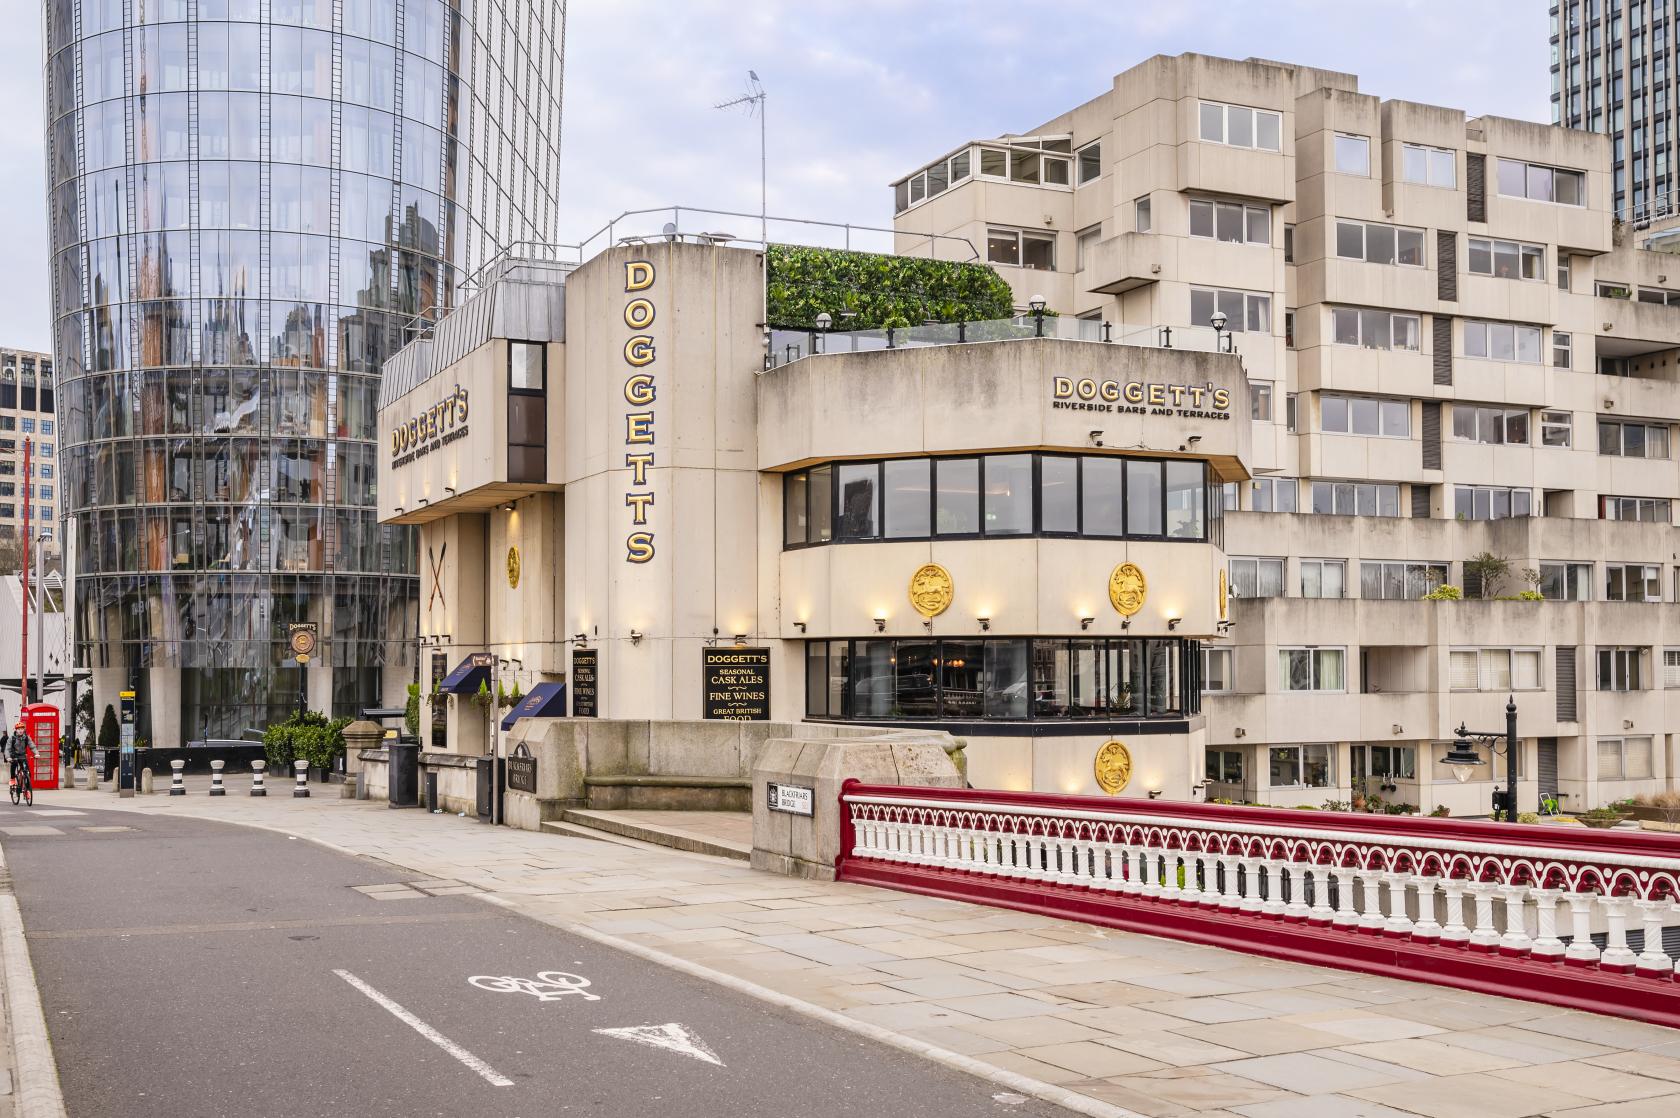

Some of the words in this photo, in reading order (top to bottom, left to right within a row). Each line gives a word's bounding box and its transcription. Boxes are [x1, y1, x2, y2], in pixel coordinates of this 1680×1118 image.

[1054, 376, 1230, 410] DOGGETT'S
[624, 260, 656, 564] DOGGETTS
[1053, 401, 1113, 413] RIVERSIDE
[1117, 405, 1147, 415] BARS
[1150, 407, 1173, 416] AND
[1176, 409, 1231, 421] TERRACES
[391, 383, 469, 457] DOGGETT'S
[707, 655, 768, 663] DOGGETT'S
[711, 676, 737, 685] CASK
[739, 675, 763, 684] ALES
[709, 692, 732, 701] FINE
[733, 691, 765, 700] WINES
[781, 789, 808, 800] BLACKFRIARS
